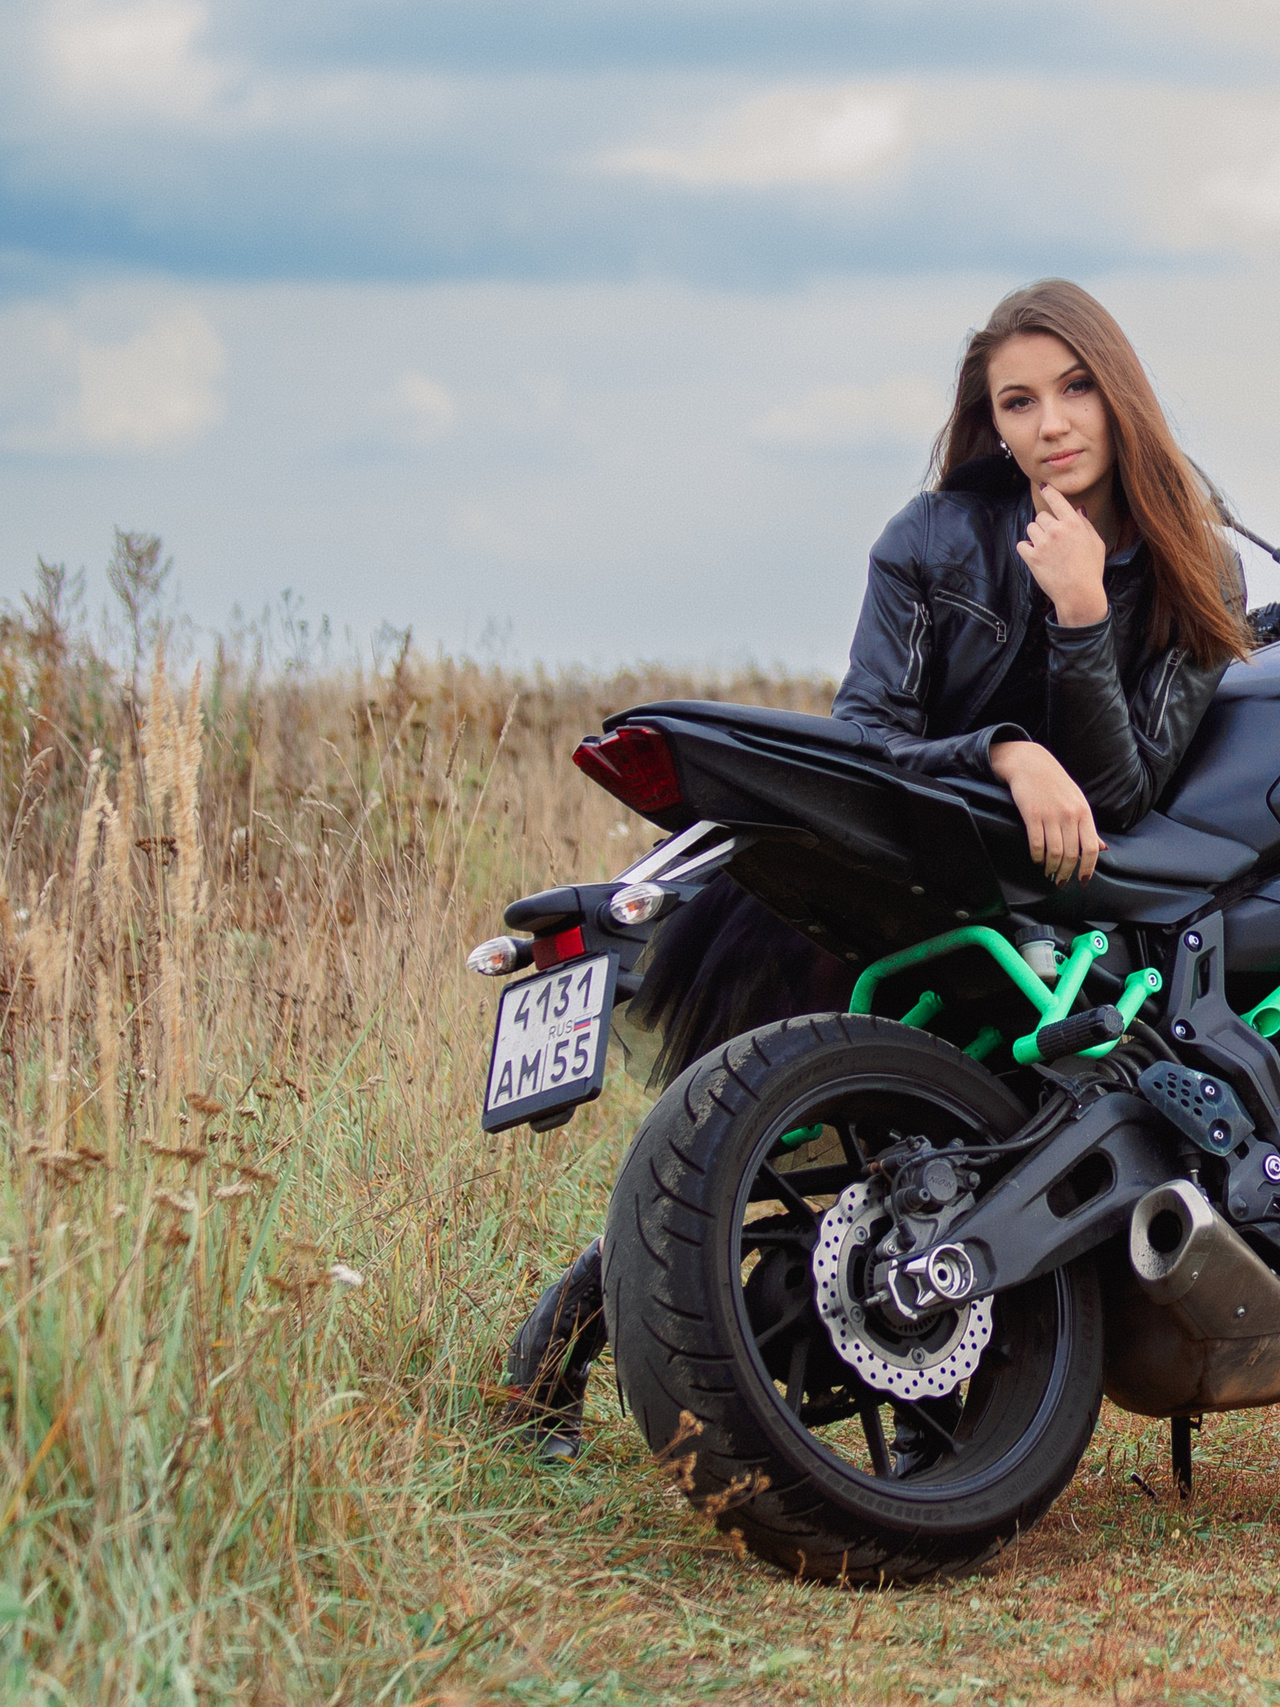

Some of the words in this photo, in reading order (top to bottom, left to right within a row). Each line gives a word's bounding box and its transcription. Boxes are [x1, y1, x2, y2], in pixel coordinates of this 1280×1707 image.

[513, 966, 593, 1031] 4131
[549, 1020, 573, 1039] RUS
[494, 1049, 542, 1104] AM
[550, 1032, 591, 1083] 55
